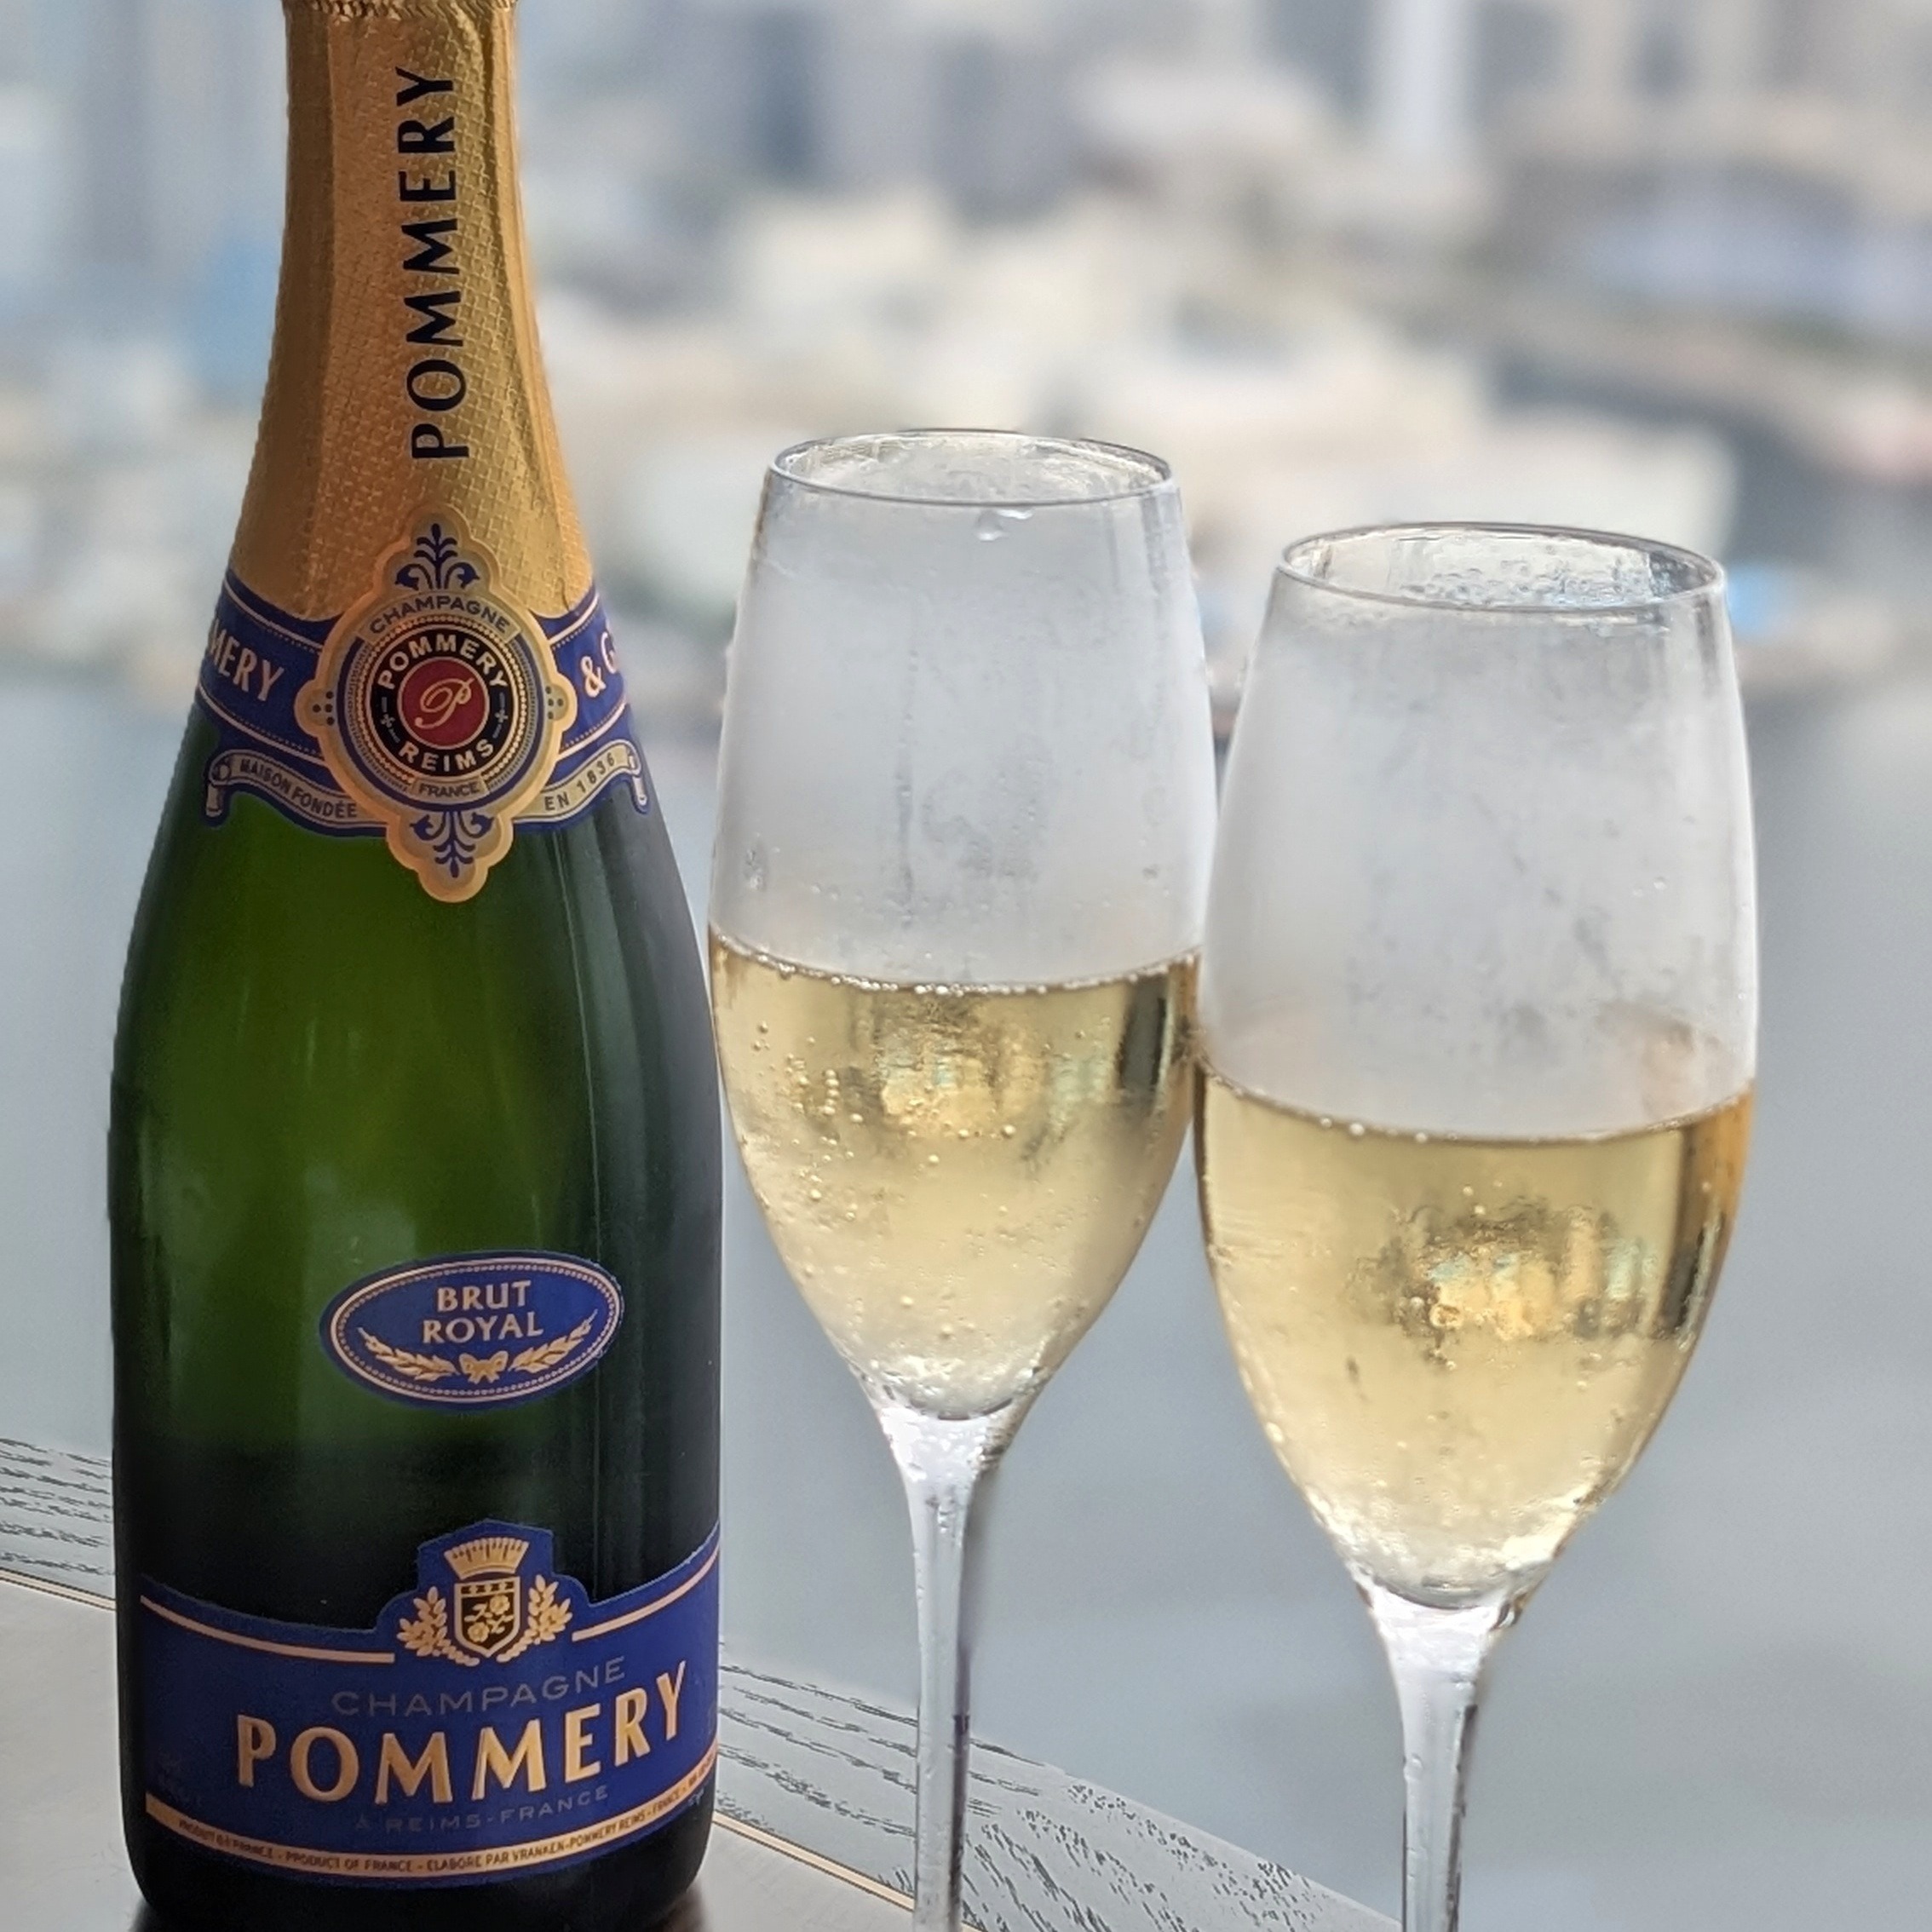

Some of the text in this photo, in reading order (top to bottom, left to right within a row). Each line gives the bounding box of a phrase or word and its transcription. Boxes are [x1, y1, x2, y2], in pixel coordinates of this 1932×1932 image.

[395, 66, 469, 460] POMMERY
[370, 595, 511, 635] CHAMPAGNE
[377, 634, 509, 691] POMMERY
[580, 655, 607, 698] &
[399, 739, 494, 772] REIMS
[240, 758, 292, 794] MAISON
[544, 793, 570, 811] EN
[576, 752, 616, 793] 1836
[418, 780, 480, 798] FRANCE
[437, 1280, 532, 1313] BRUT
[423, 1311, 544, 1344] ROYAL
[331, 1656, 625, 1716] CHAMPAGNE
[237, 1660, 687, 1805] POMMERY
[285, 1851, 340, 1869] PRODUCT
[364, 1860, 412, 1872] FRANCE
[486, 1849, 509, 1865] PAR
